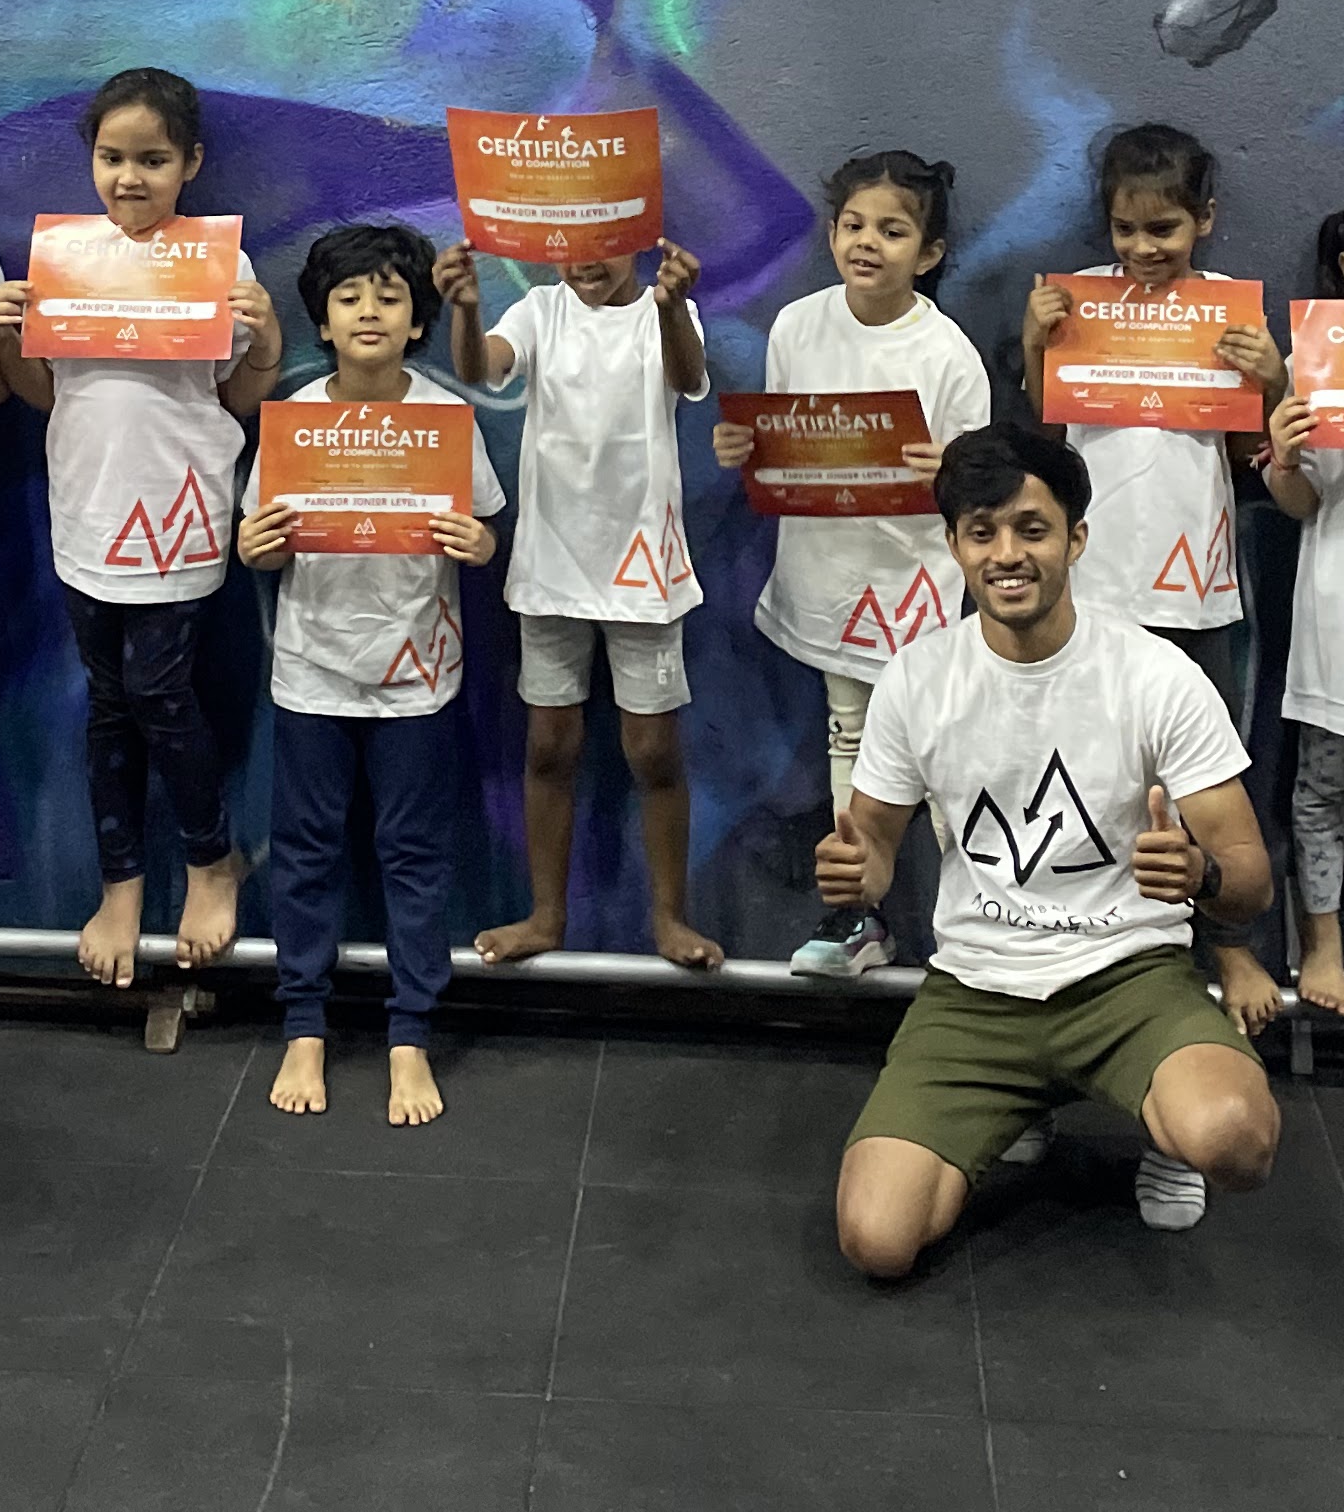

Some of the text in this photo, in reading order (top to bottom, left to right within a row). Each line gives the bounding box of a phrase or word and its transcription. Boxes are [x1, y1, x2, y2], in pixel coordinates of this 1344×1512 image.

[477, 136, 626, 159] CERTIFICATE
[526, 159, 590, 169] COMPLETION
[580, 208, 609, 219] LEVEL
[156, 305, 182, 315] LEVEL
[1079, 301, 1227, 323] CERTIFICATE
[1128, 322, 1192, 331] COMPLETION
[1178, 371, 1206, 382] LEVEL
[756, 413, 895, 431] CERTIFICATE
[294, 429, 440, 448] CERTIFICATE
[328, 448, 406, 457] OF COMPLETION
[390, 498, 418, 507] LEVEL
